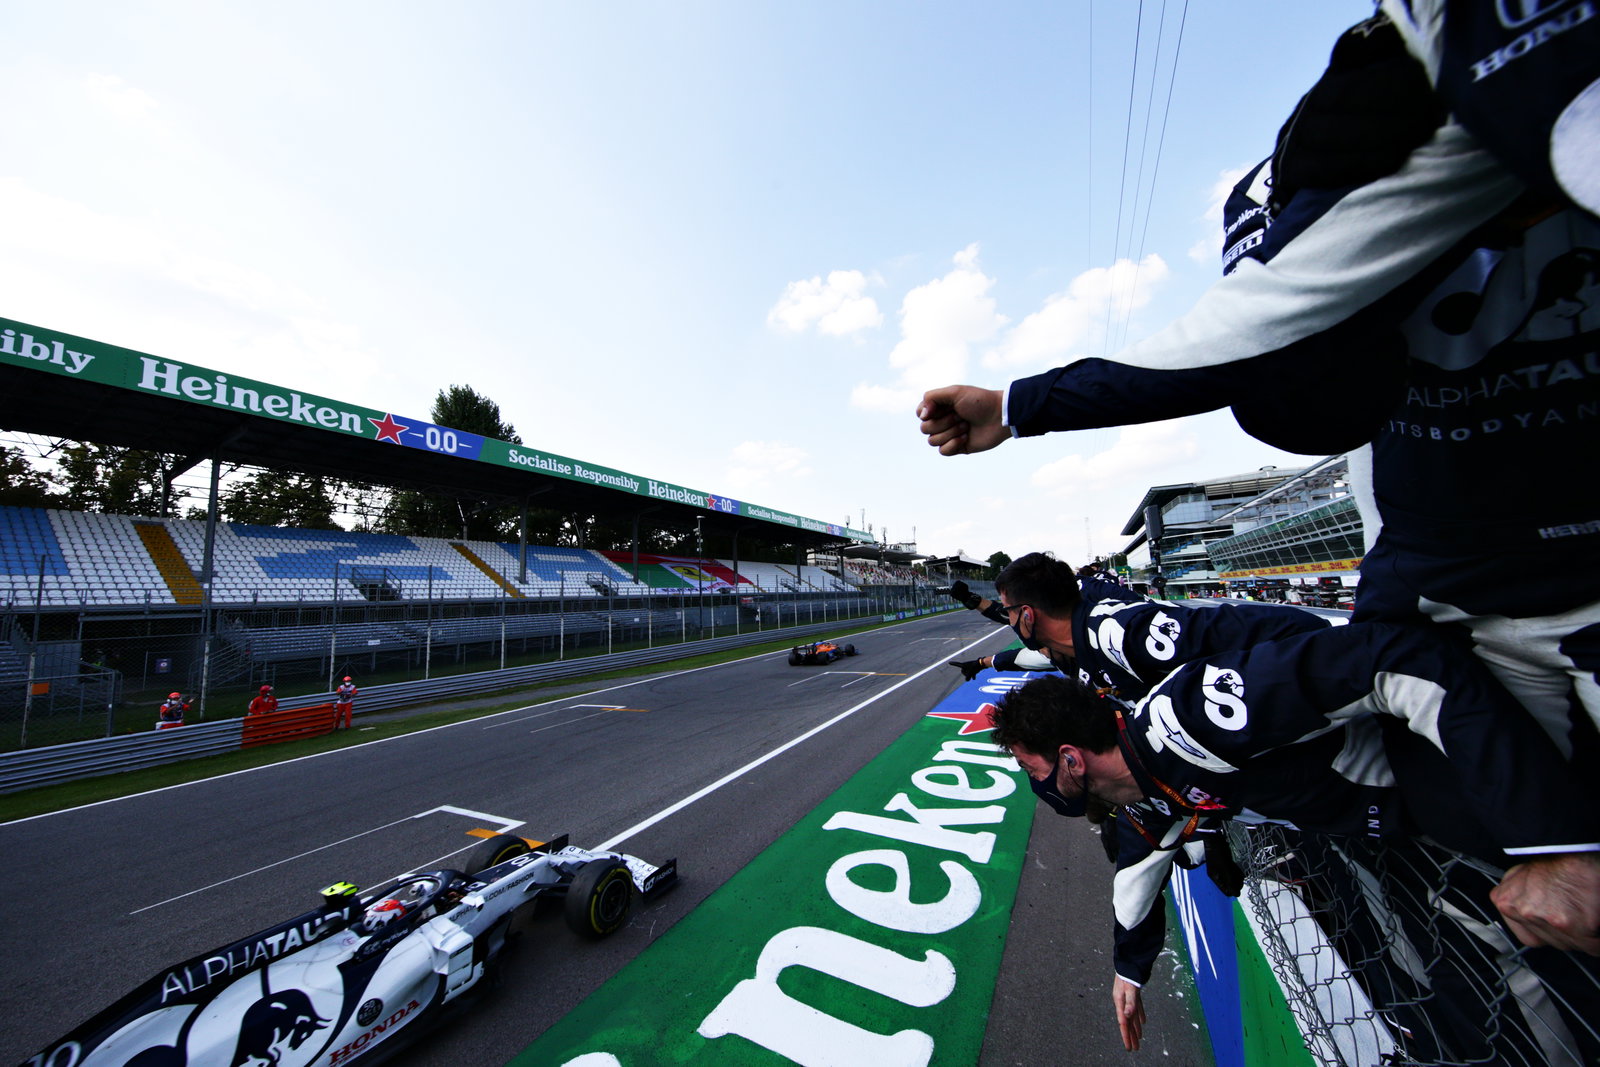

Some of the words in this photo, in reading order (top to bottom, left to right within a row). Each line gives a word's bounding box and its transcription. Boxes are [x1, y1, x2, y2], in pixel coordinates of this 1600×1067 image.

[138, 357, 363, 434] Heineken
[508, 449, 571, 475] Socialise
[574, 464, 639, 492] Responsibly
[648, 480, 704, 507] Heineken
[801, 517, 826, 532] Heineken
[560, 740, 1022, 1067] neken
[329, 1000, 420, 1066] HONDA
